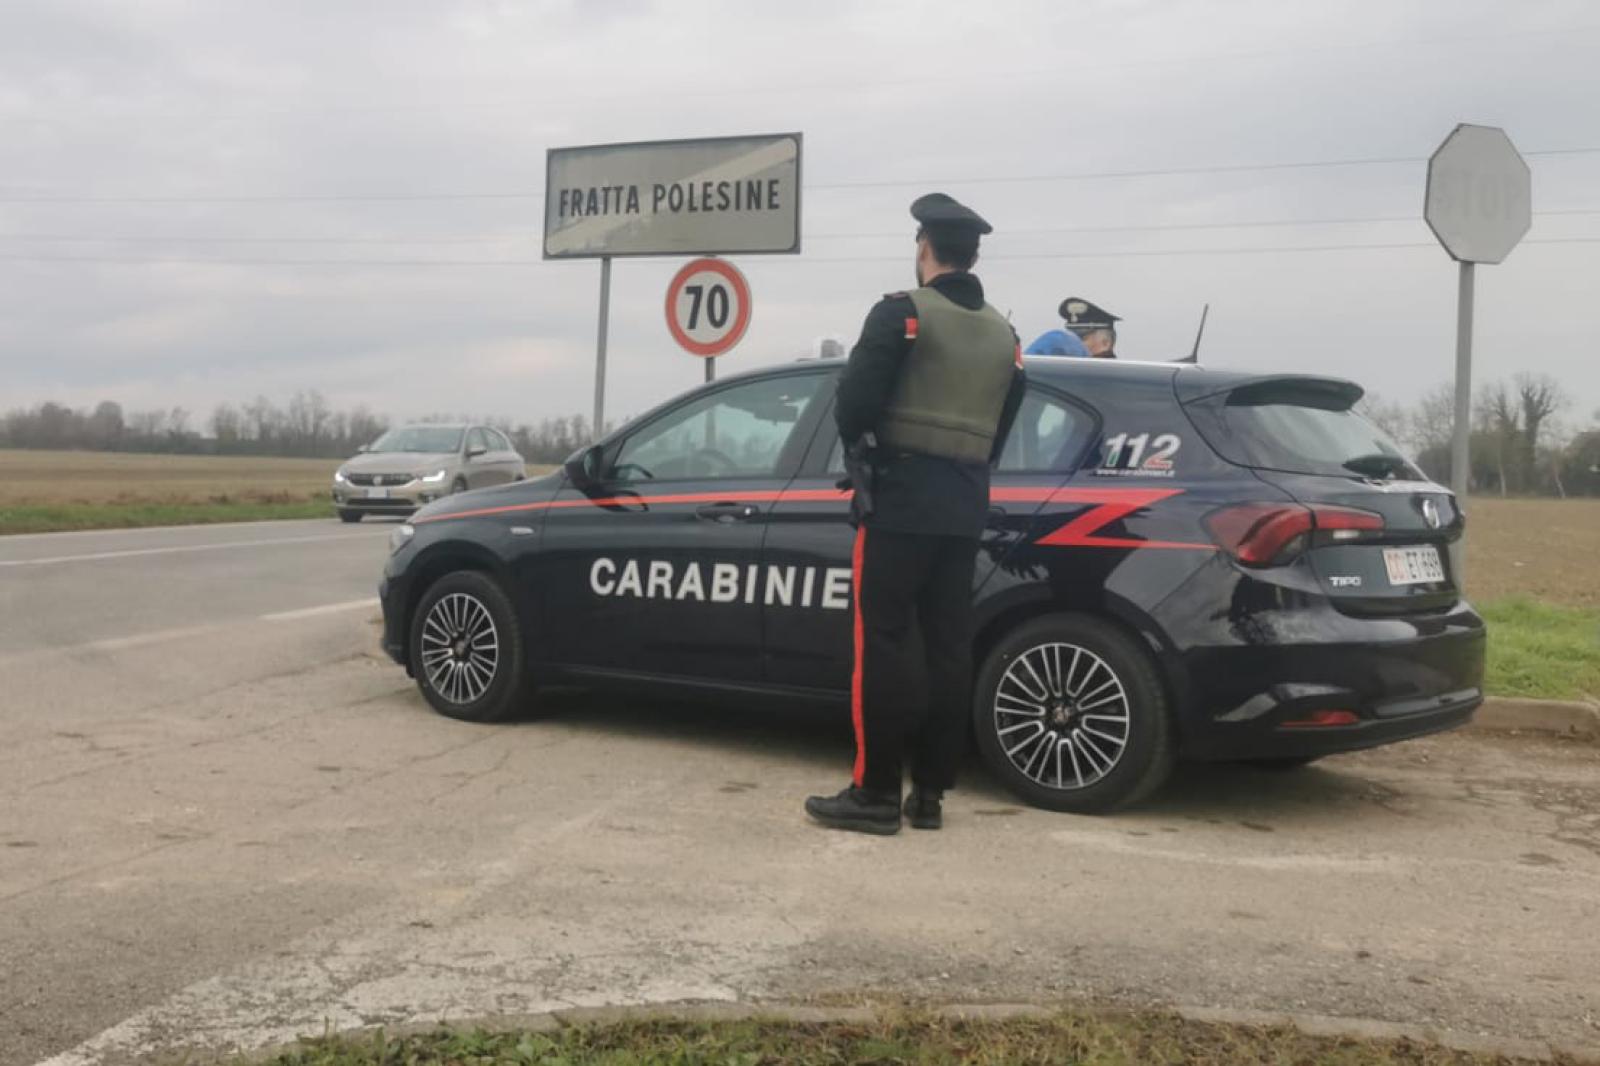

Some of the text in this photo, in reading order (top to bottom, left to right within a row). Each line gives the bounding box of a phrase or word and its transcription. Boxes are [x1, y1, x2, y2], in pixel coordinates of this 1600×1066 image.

[560, 179, 780, 217] FRATTA POLESINE
[685, 284, 730, 330] 70
[1106, 432, 1180, 468] 112
[589, 557, 853, 609] CARABINIE
[1328, 576, 1362, 587] TIPO
